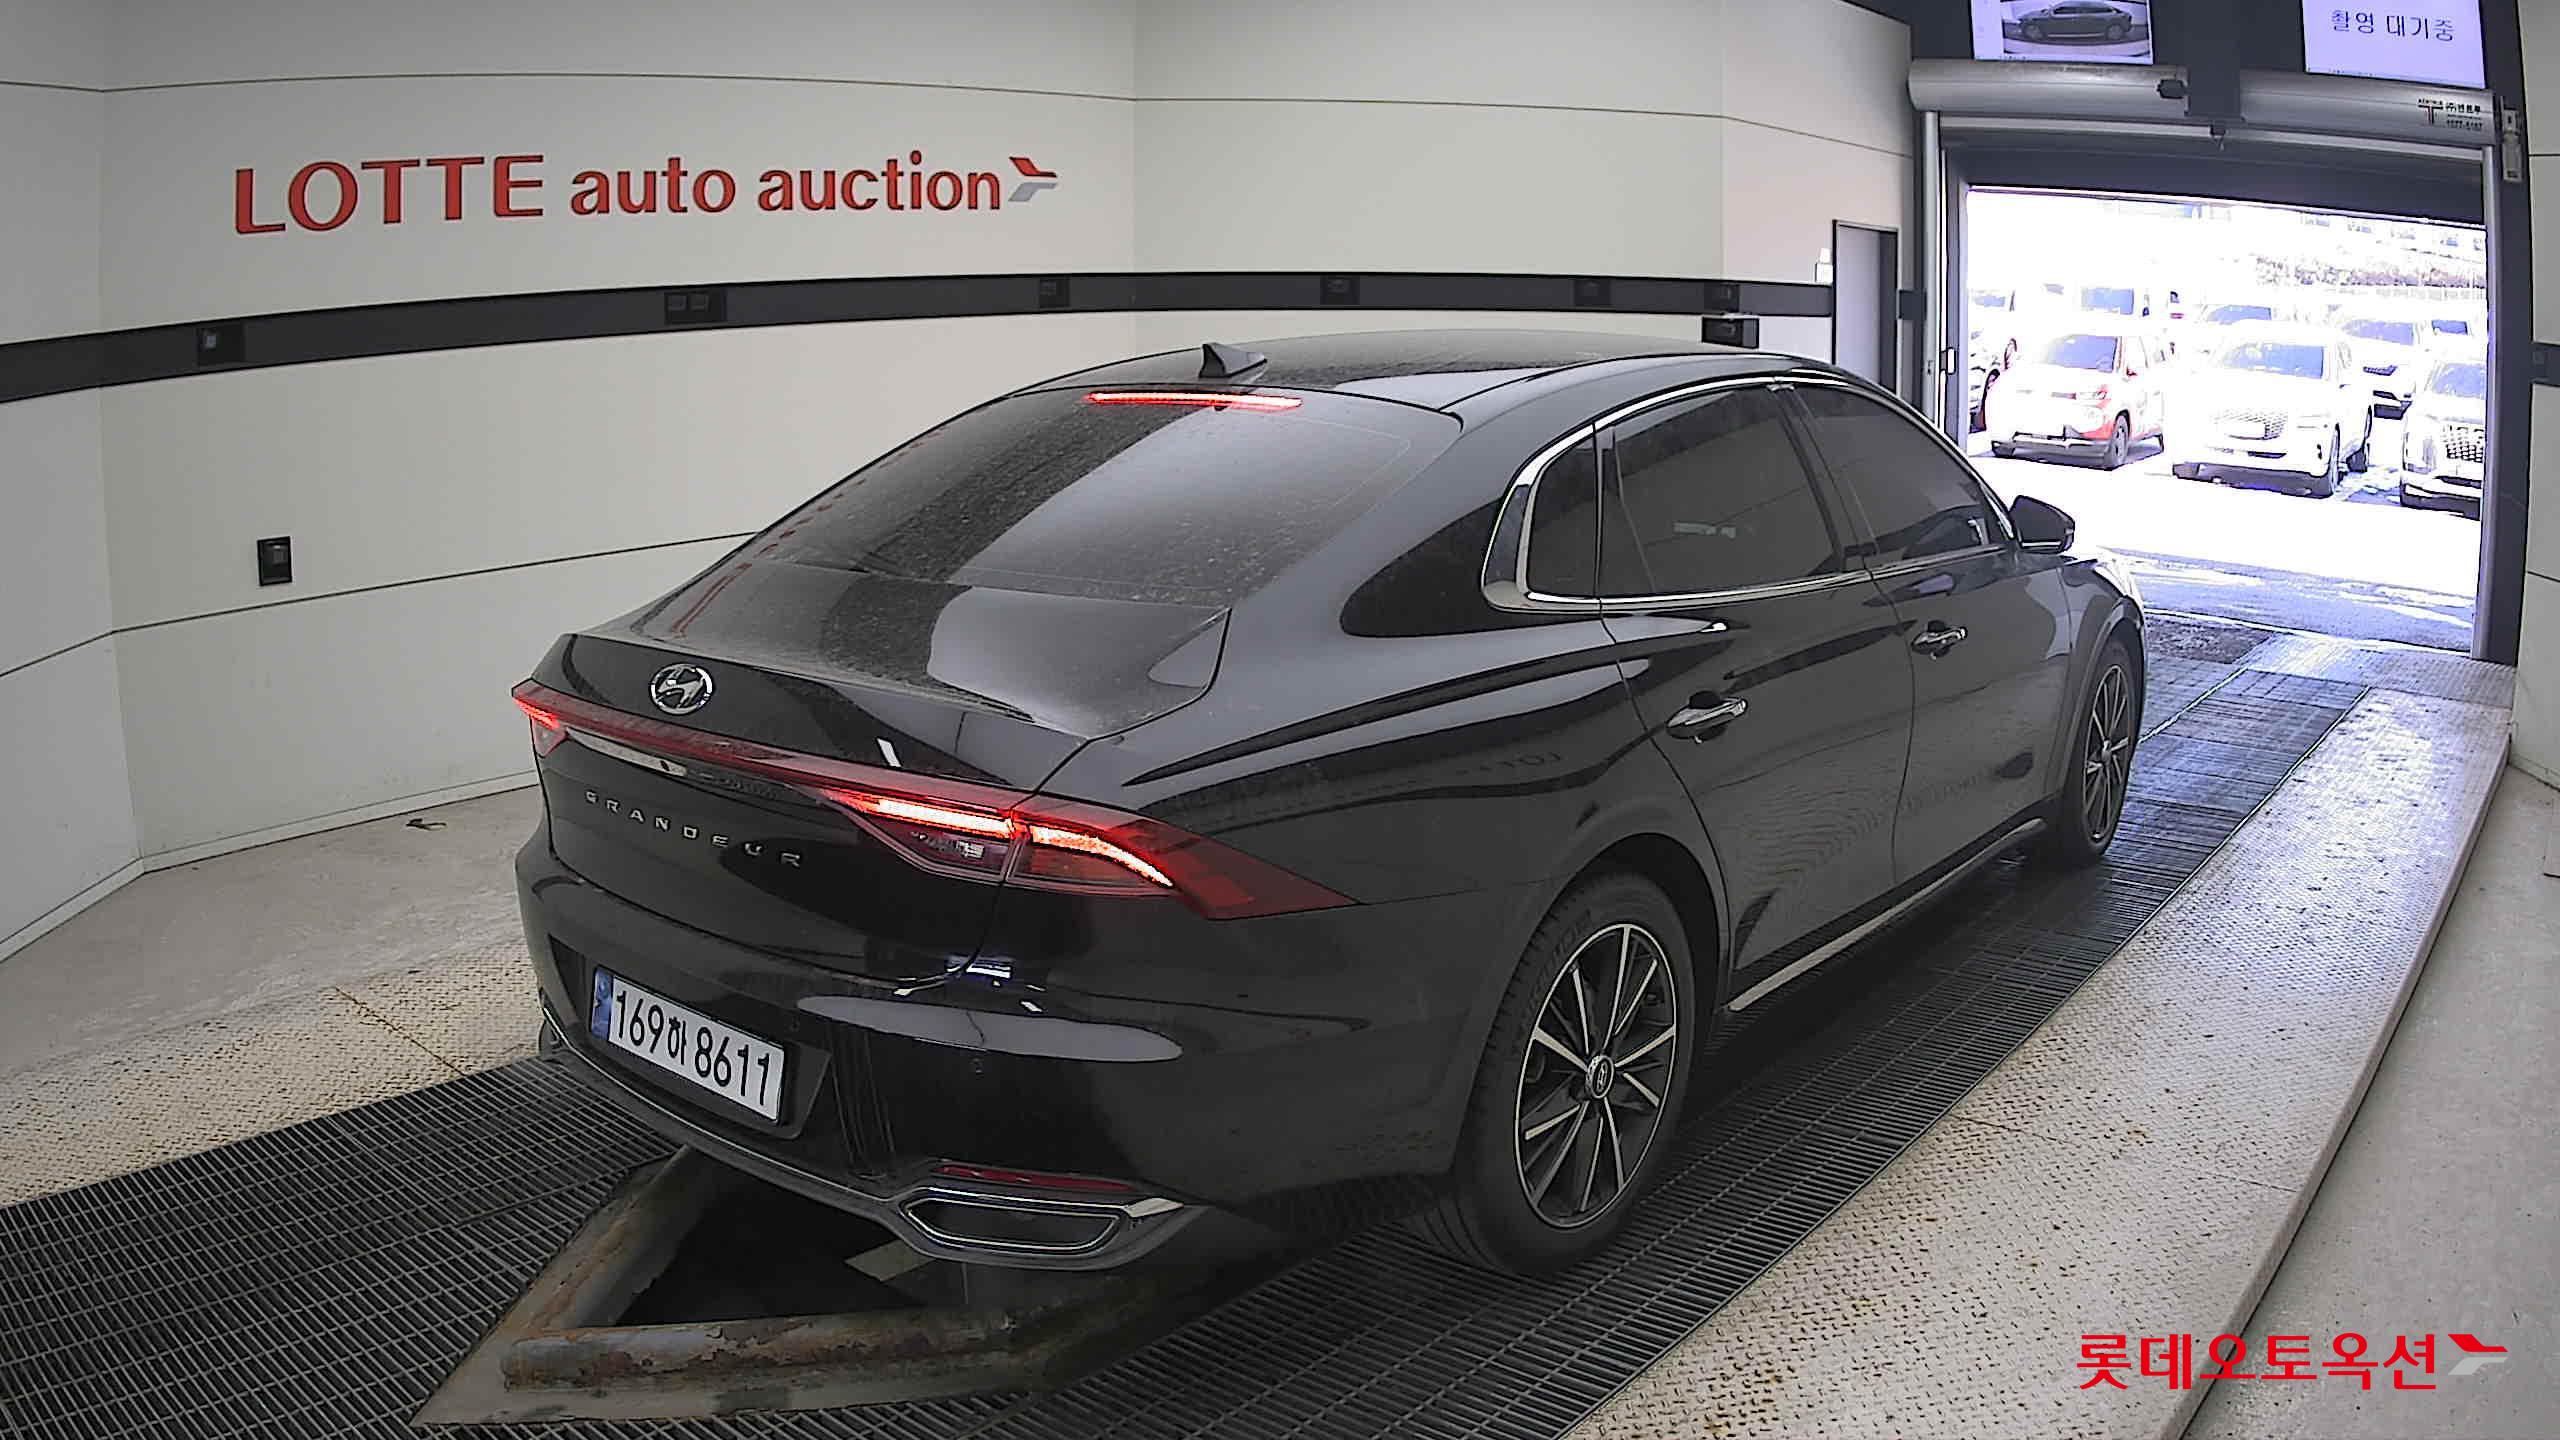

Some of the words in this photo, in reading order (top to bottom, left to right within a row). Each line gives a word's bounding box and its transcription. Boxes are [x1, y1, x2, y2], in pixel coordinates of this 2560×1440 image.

[2331, 10, 2375, 34] 촬영
[2386, 15, 2454, 42] 대기중
[235, 154, 545, 235] LOTTE
[570, 156, 737, 216] auto
[757, 149, 1002, 212] auction
[585, 790, 801, 868] GRANDEUR
[694, 1026, 771, 1107] 8611
